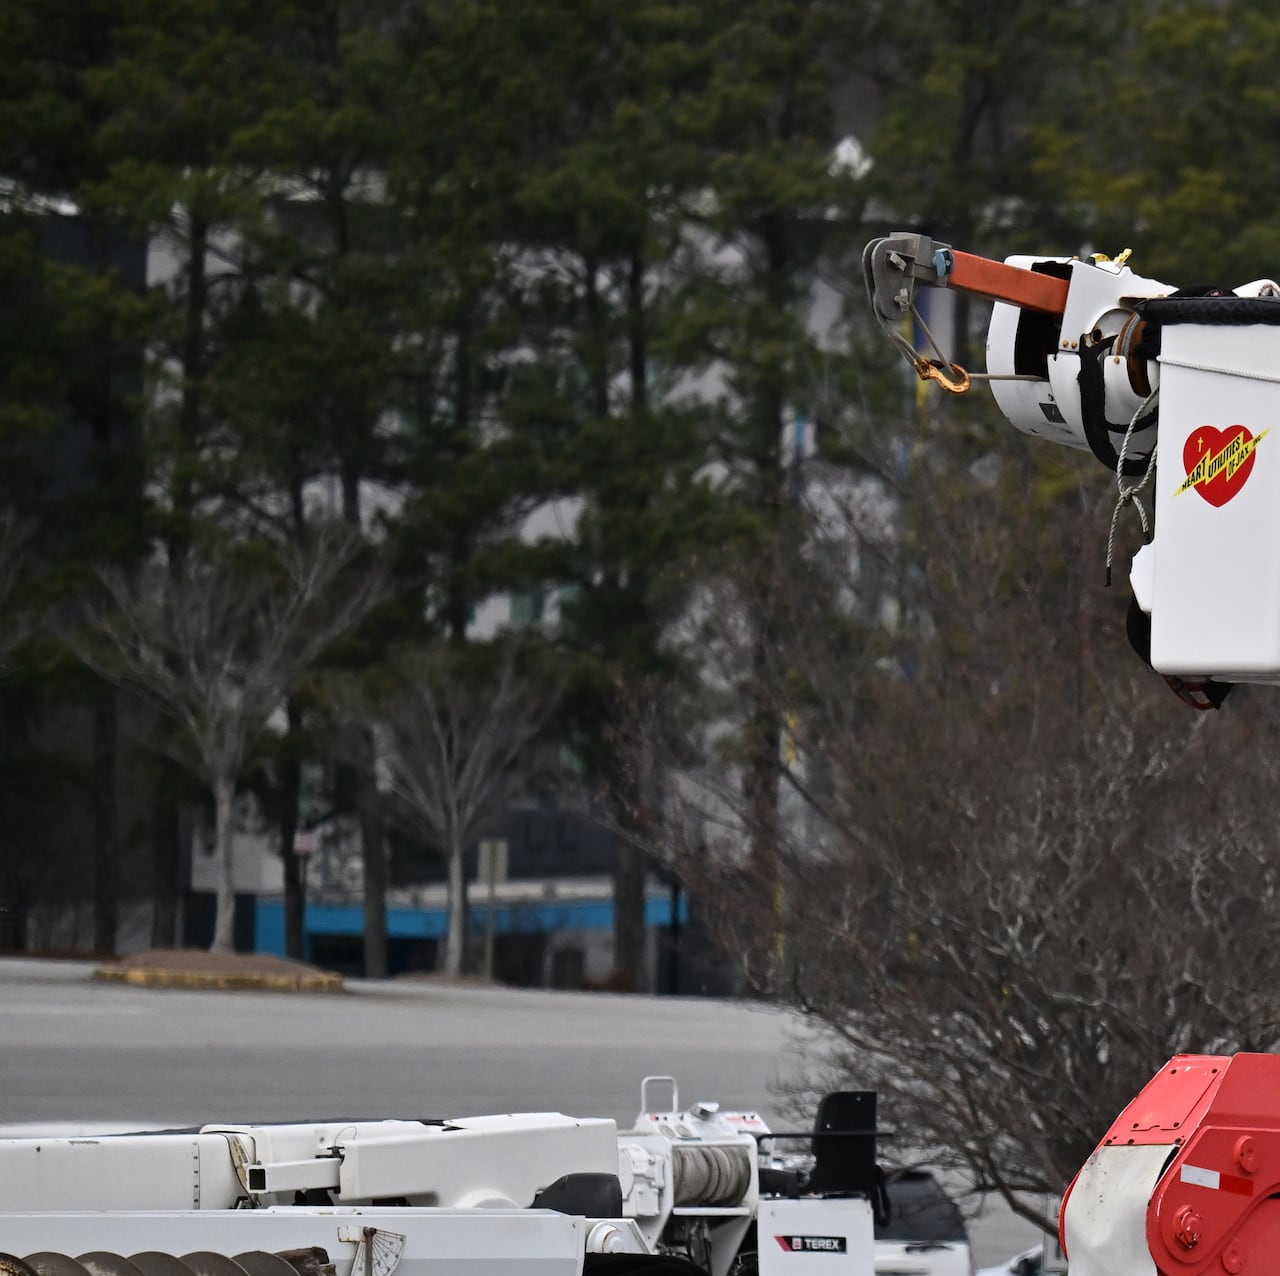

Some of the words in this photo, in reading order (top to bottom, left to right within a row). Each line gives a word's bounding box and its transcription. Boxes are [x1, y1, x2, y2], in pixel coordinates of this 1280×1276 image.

[1181, 456, 1207, 492] HEART
[1208, 436, 1241, 479] UTILITIES
[804, 1238, 840, 1250] TEREX
